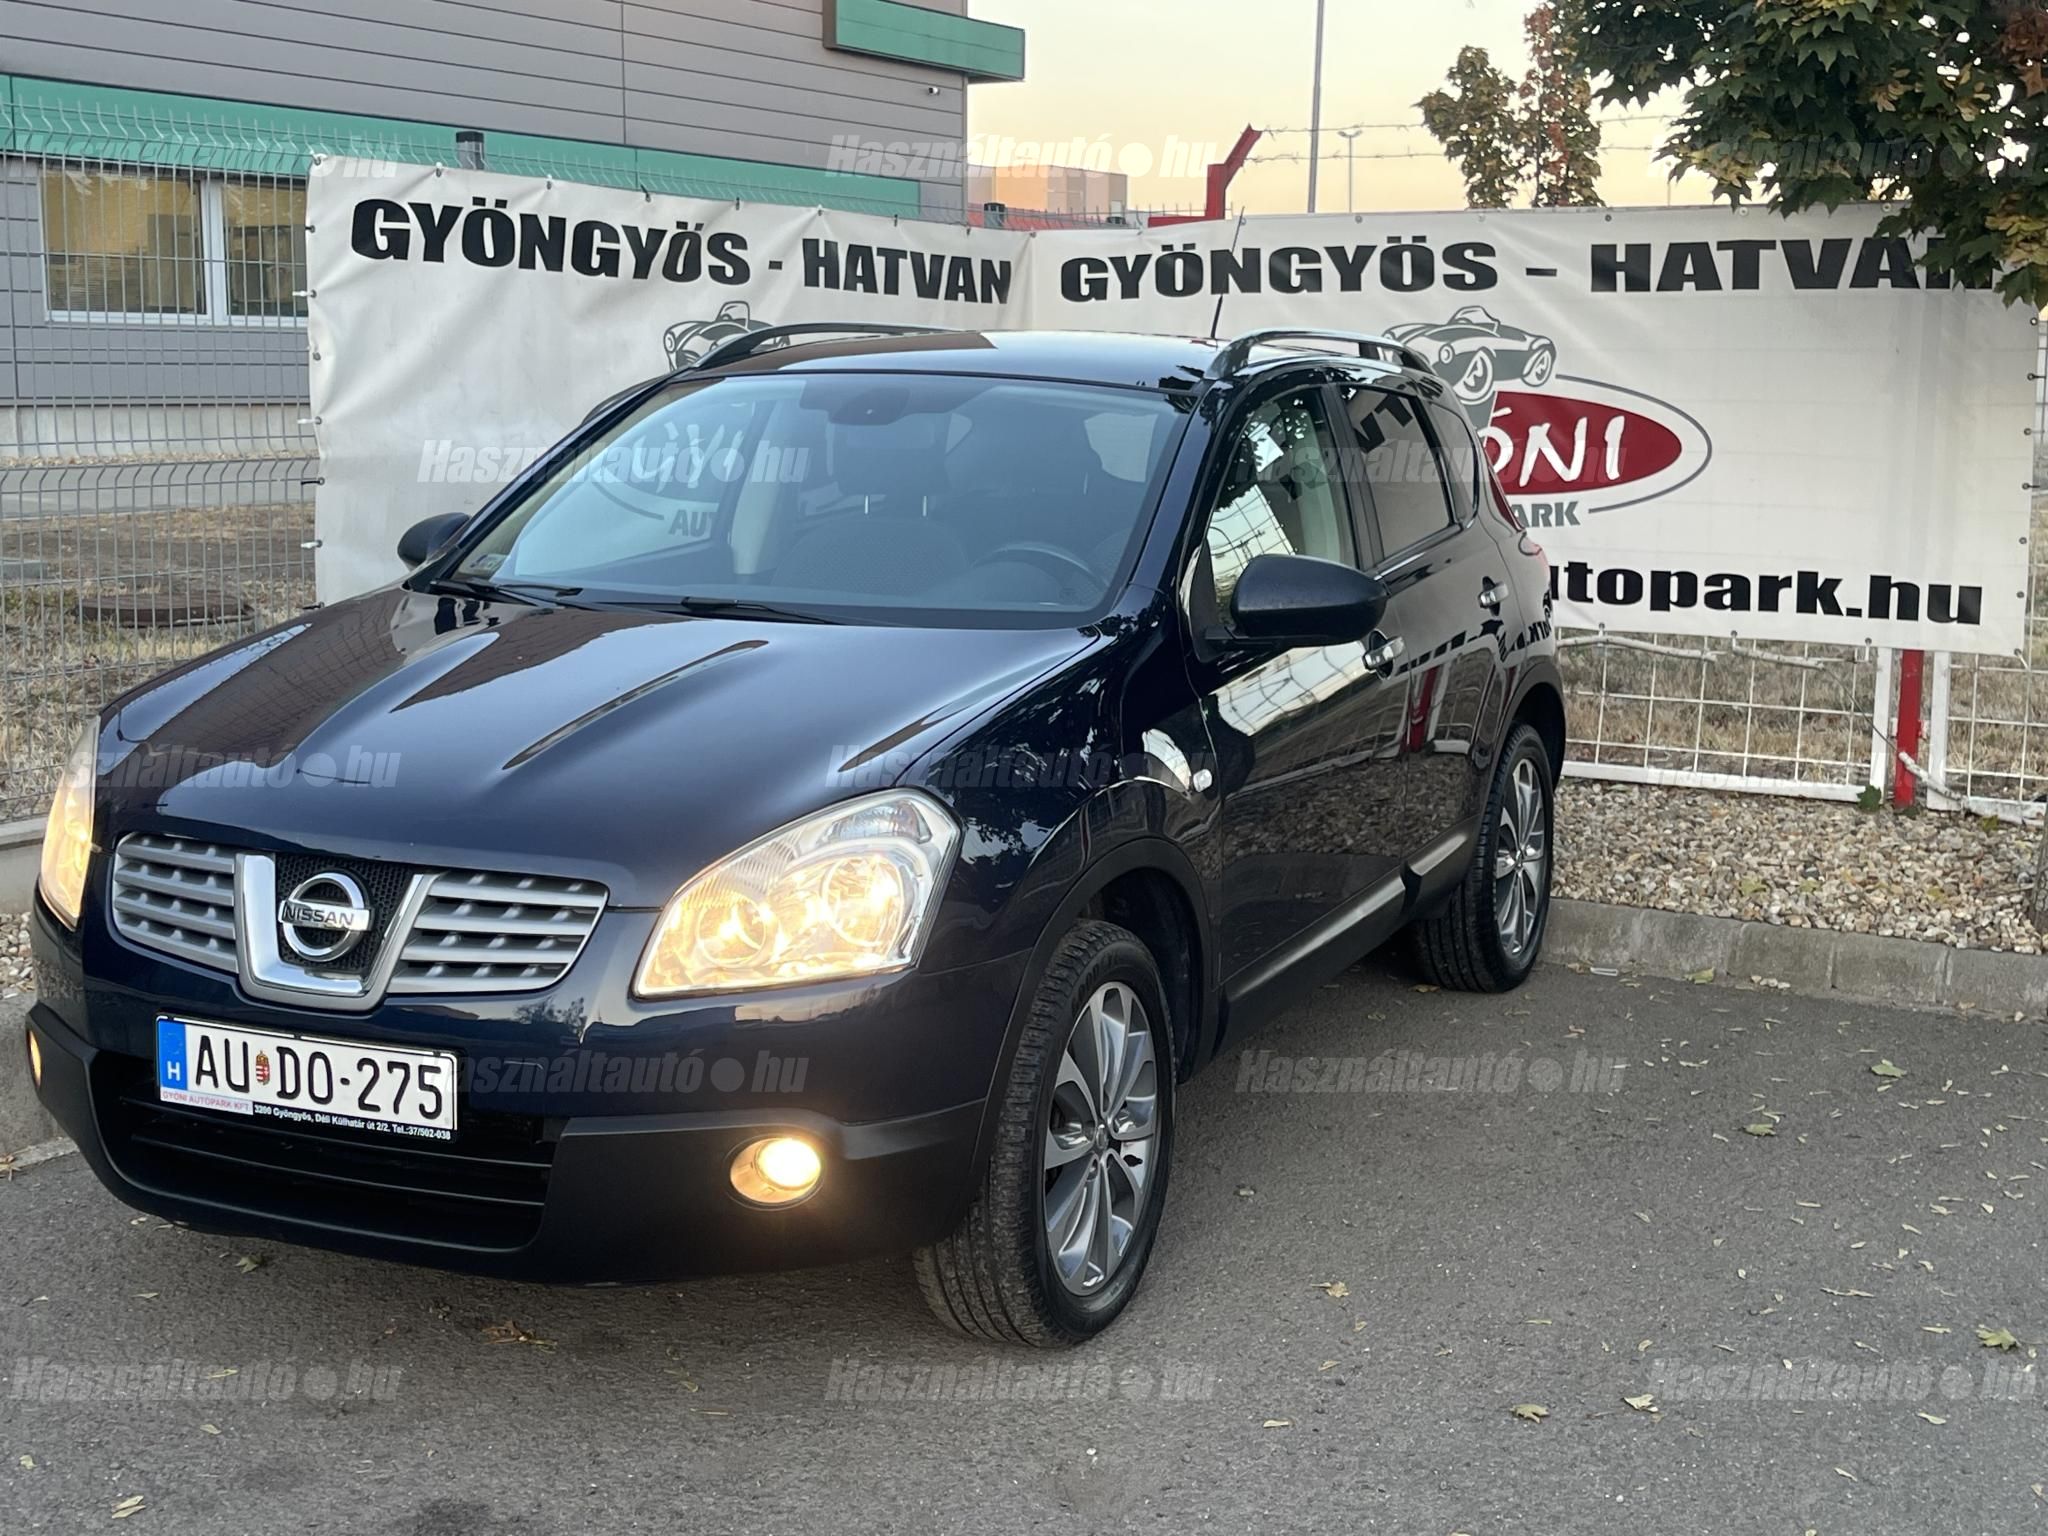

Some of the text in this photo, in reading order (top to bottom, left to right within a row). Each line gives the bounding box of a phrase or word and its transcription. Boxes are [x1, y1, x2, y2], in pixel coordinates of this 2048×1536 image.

[351, 196, 751, 286] GYÖNGYÖS
[802, 238, 1012, 304] HATVAN
[1061, 235, 1499, 302] GYÖNGYÖS
[1513, 501, 1580, 529] ARK
[1550, 561, 1983, 626] topark.hu
[283, 901, 355, 926] NISSAN
[167, 1061, 181, 1081] H
[195, 1035, 442, 1120] AU DO-275
